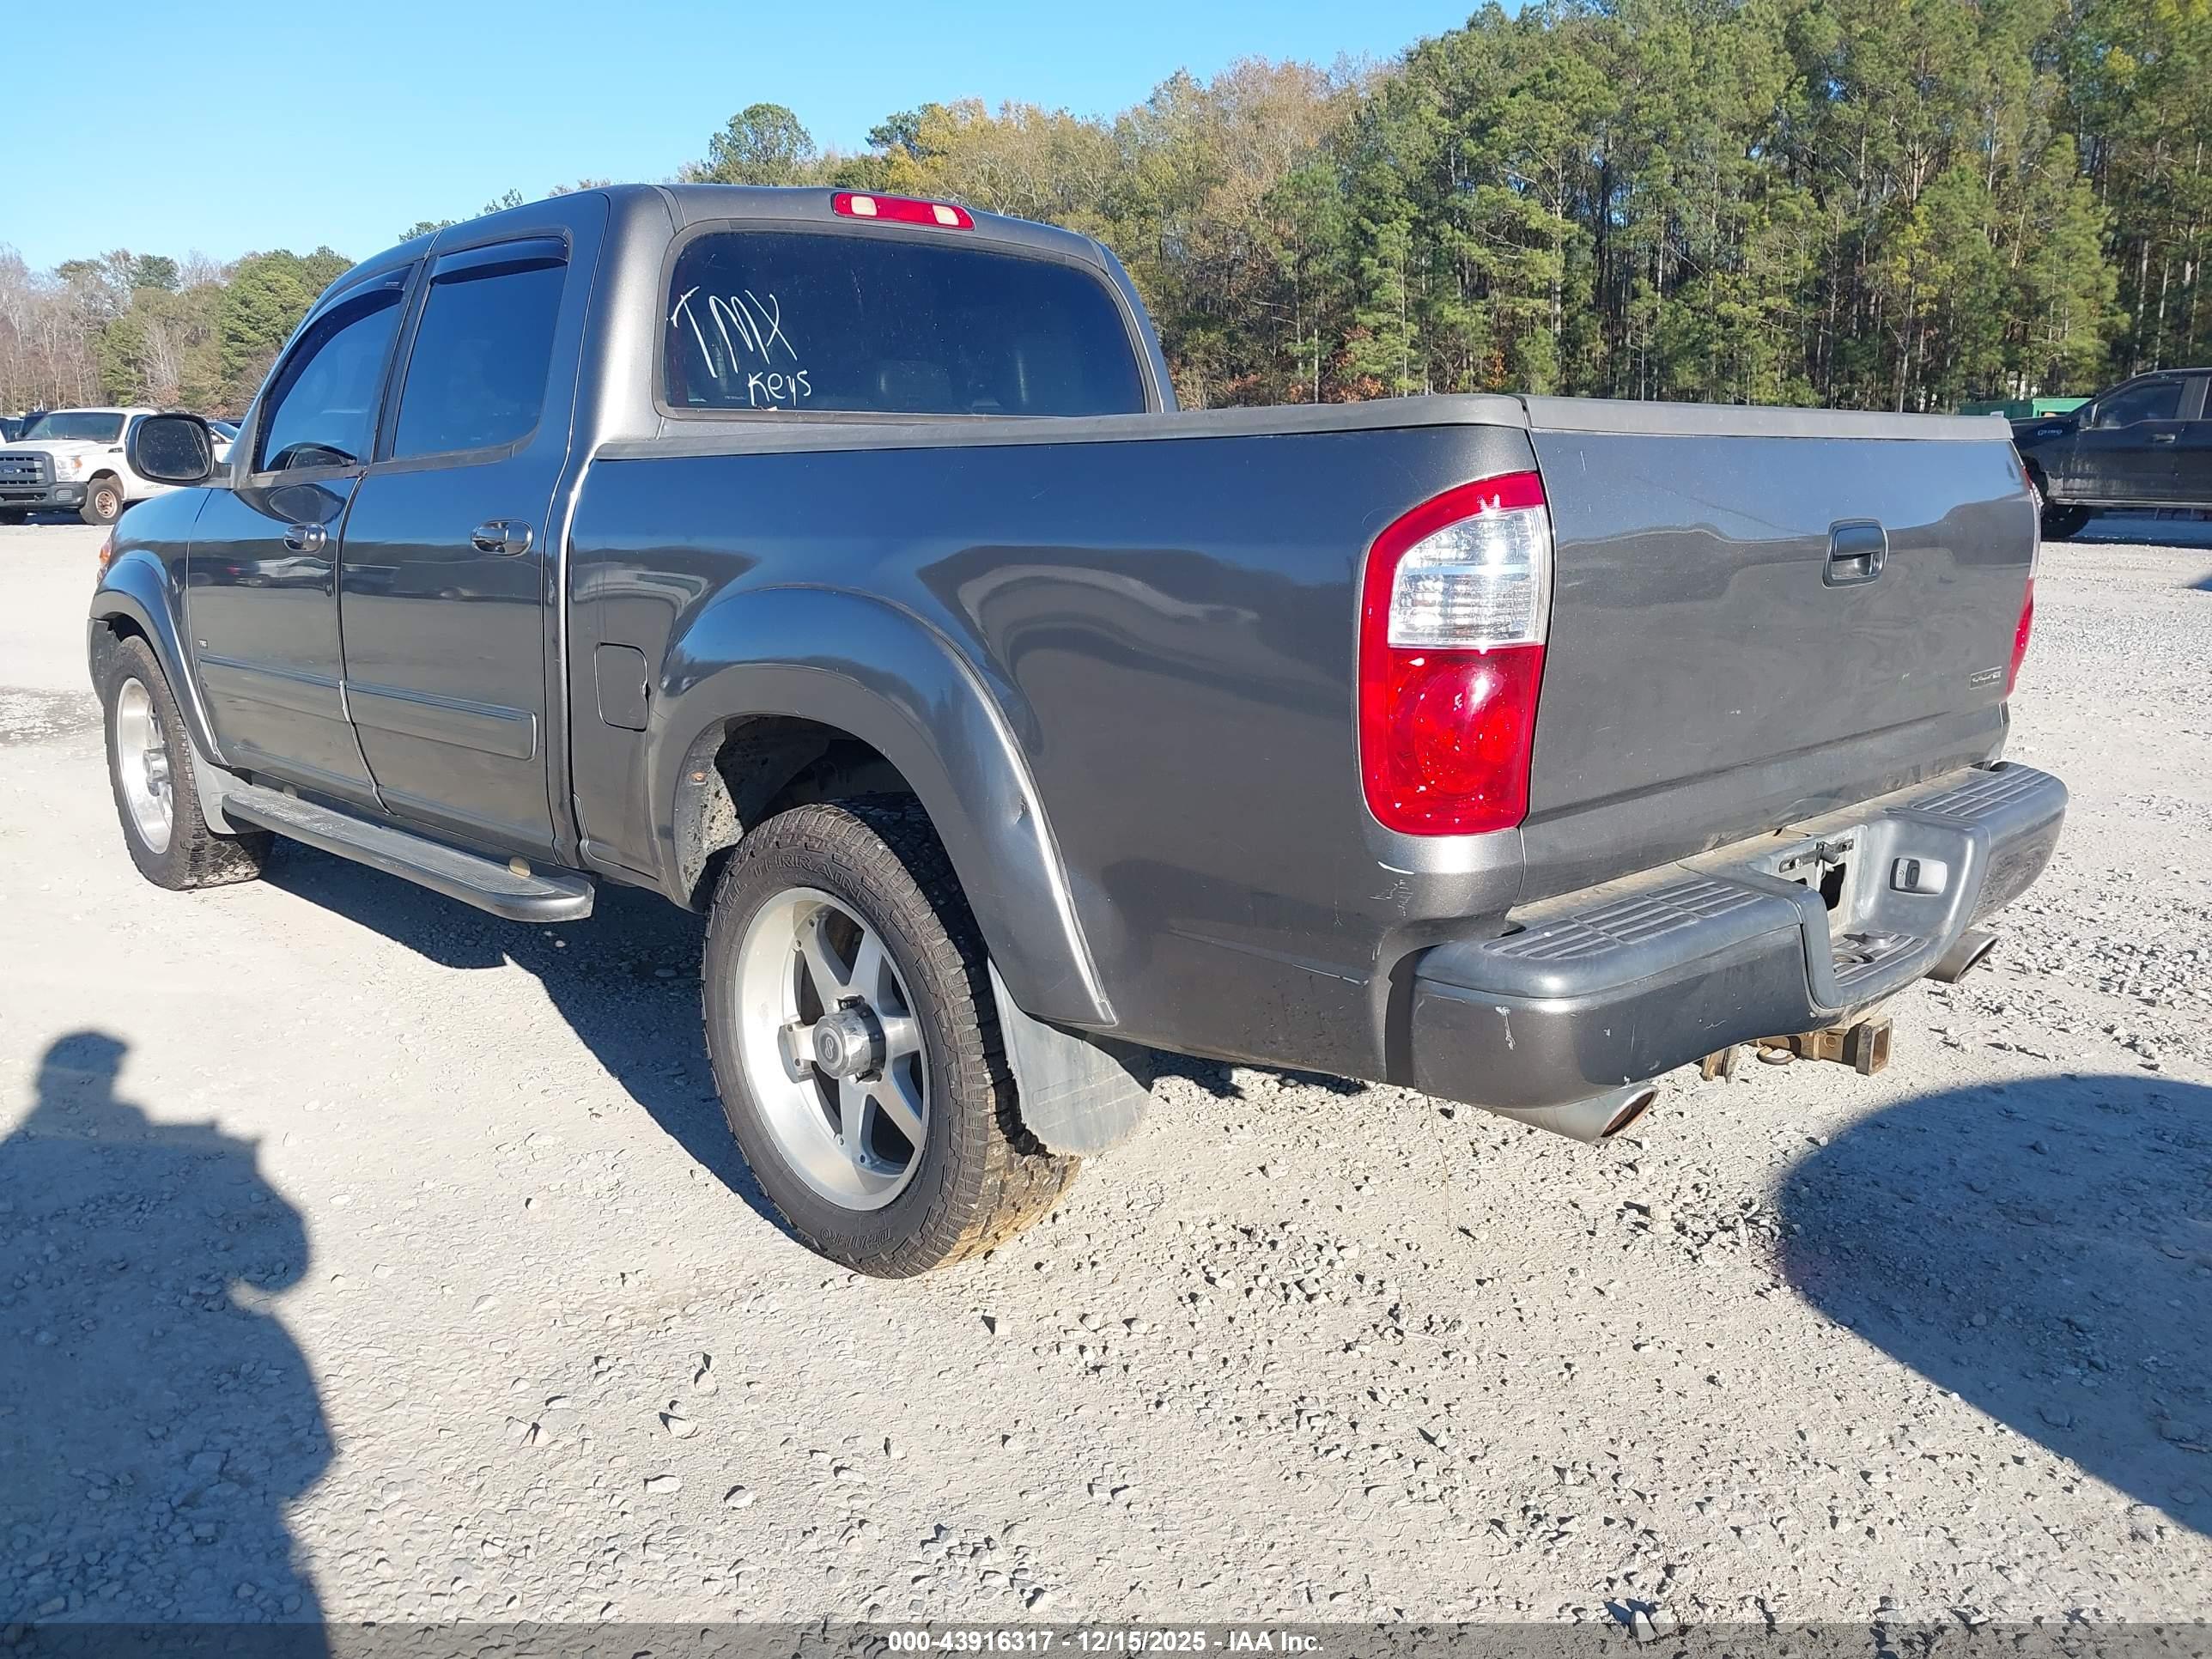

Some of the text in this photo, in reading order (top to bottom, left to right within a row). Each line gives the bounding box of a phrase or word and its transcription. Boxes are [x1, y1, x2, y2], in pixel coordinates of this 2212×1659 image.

[670, 285, 798, 379] TMX
[718, 854, 866, 932] ALL TERRAIN
